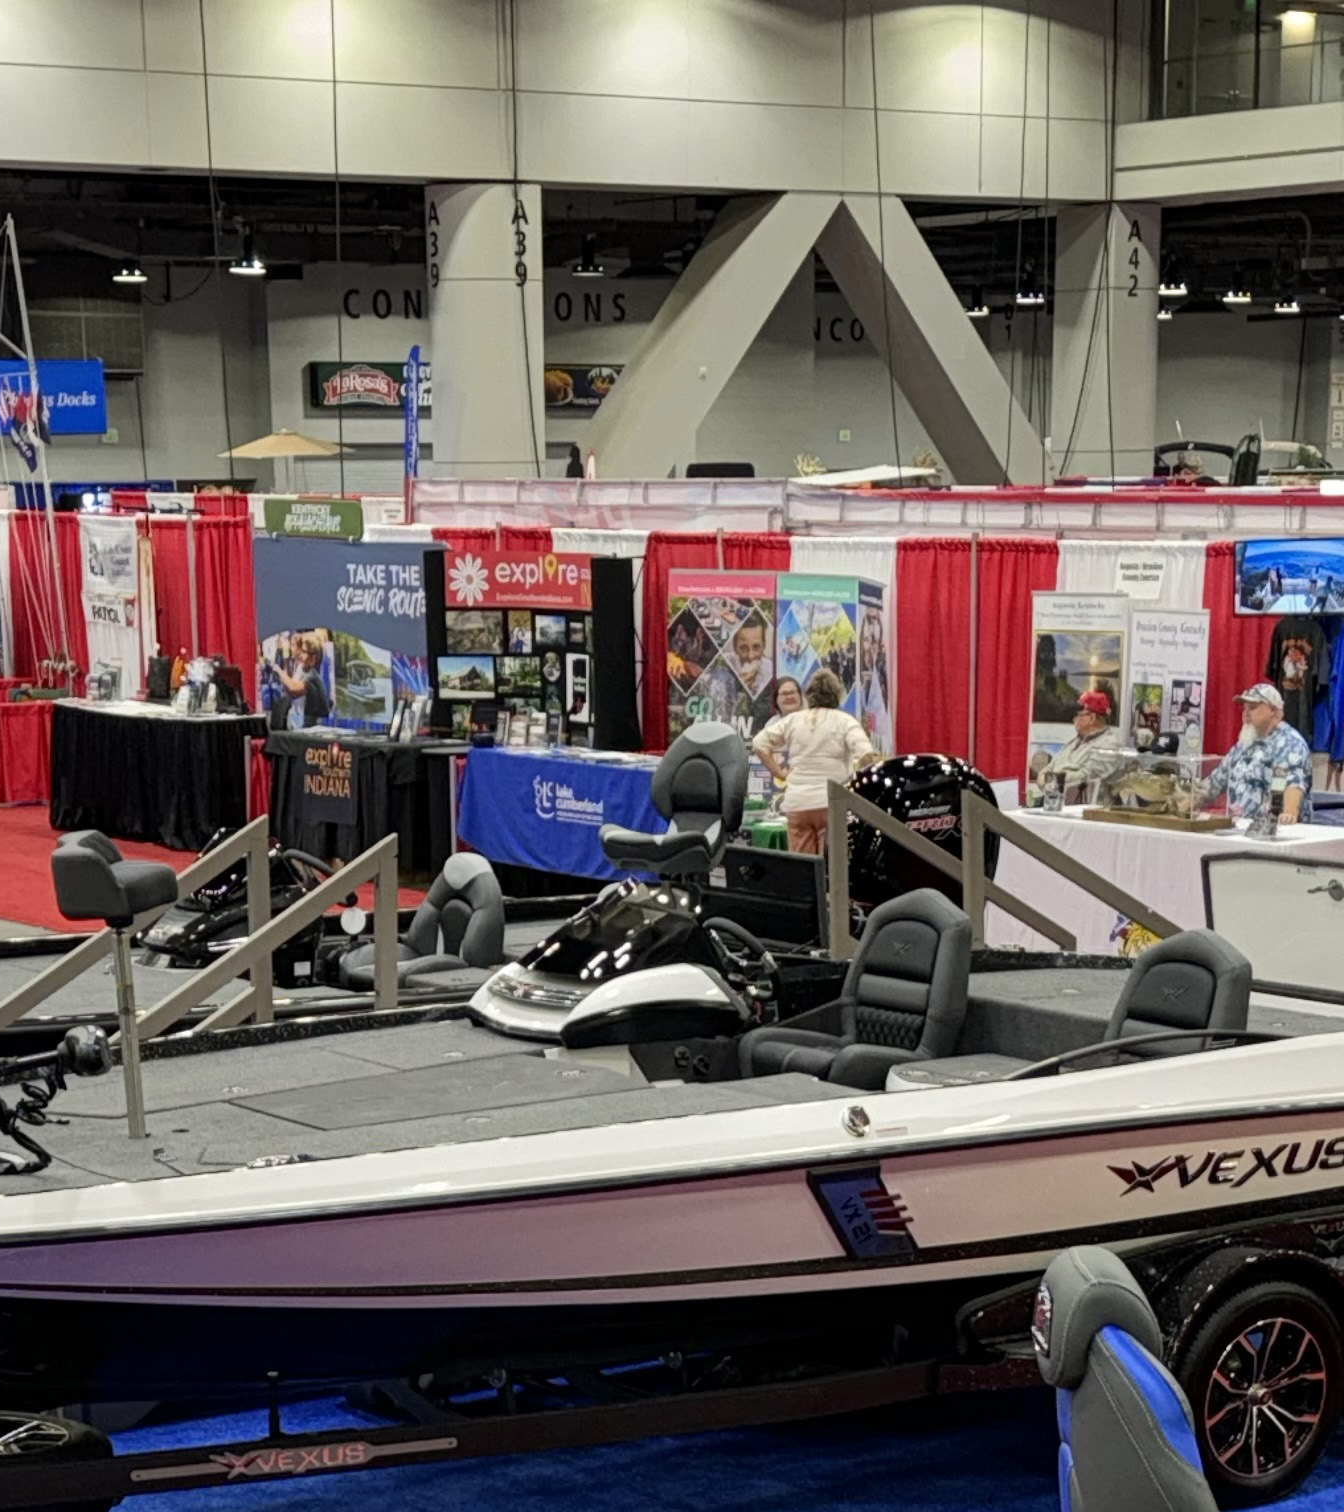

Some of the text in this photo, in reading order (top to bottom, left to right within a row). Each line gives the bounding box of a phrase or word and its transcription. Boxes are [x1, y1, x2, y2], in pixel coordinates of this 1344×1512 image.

[345, 563, 421, 586] TAKE THE
[336, 586, 385, 615] SCENIC
[684, 696, 714, 718] GO
[255, 1443, 367, 1475] VEXUS
